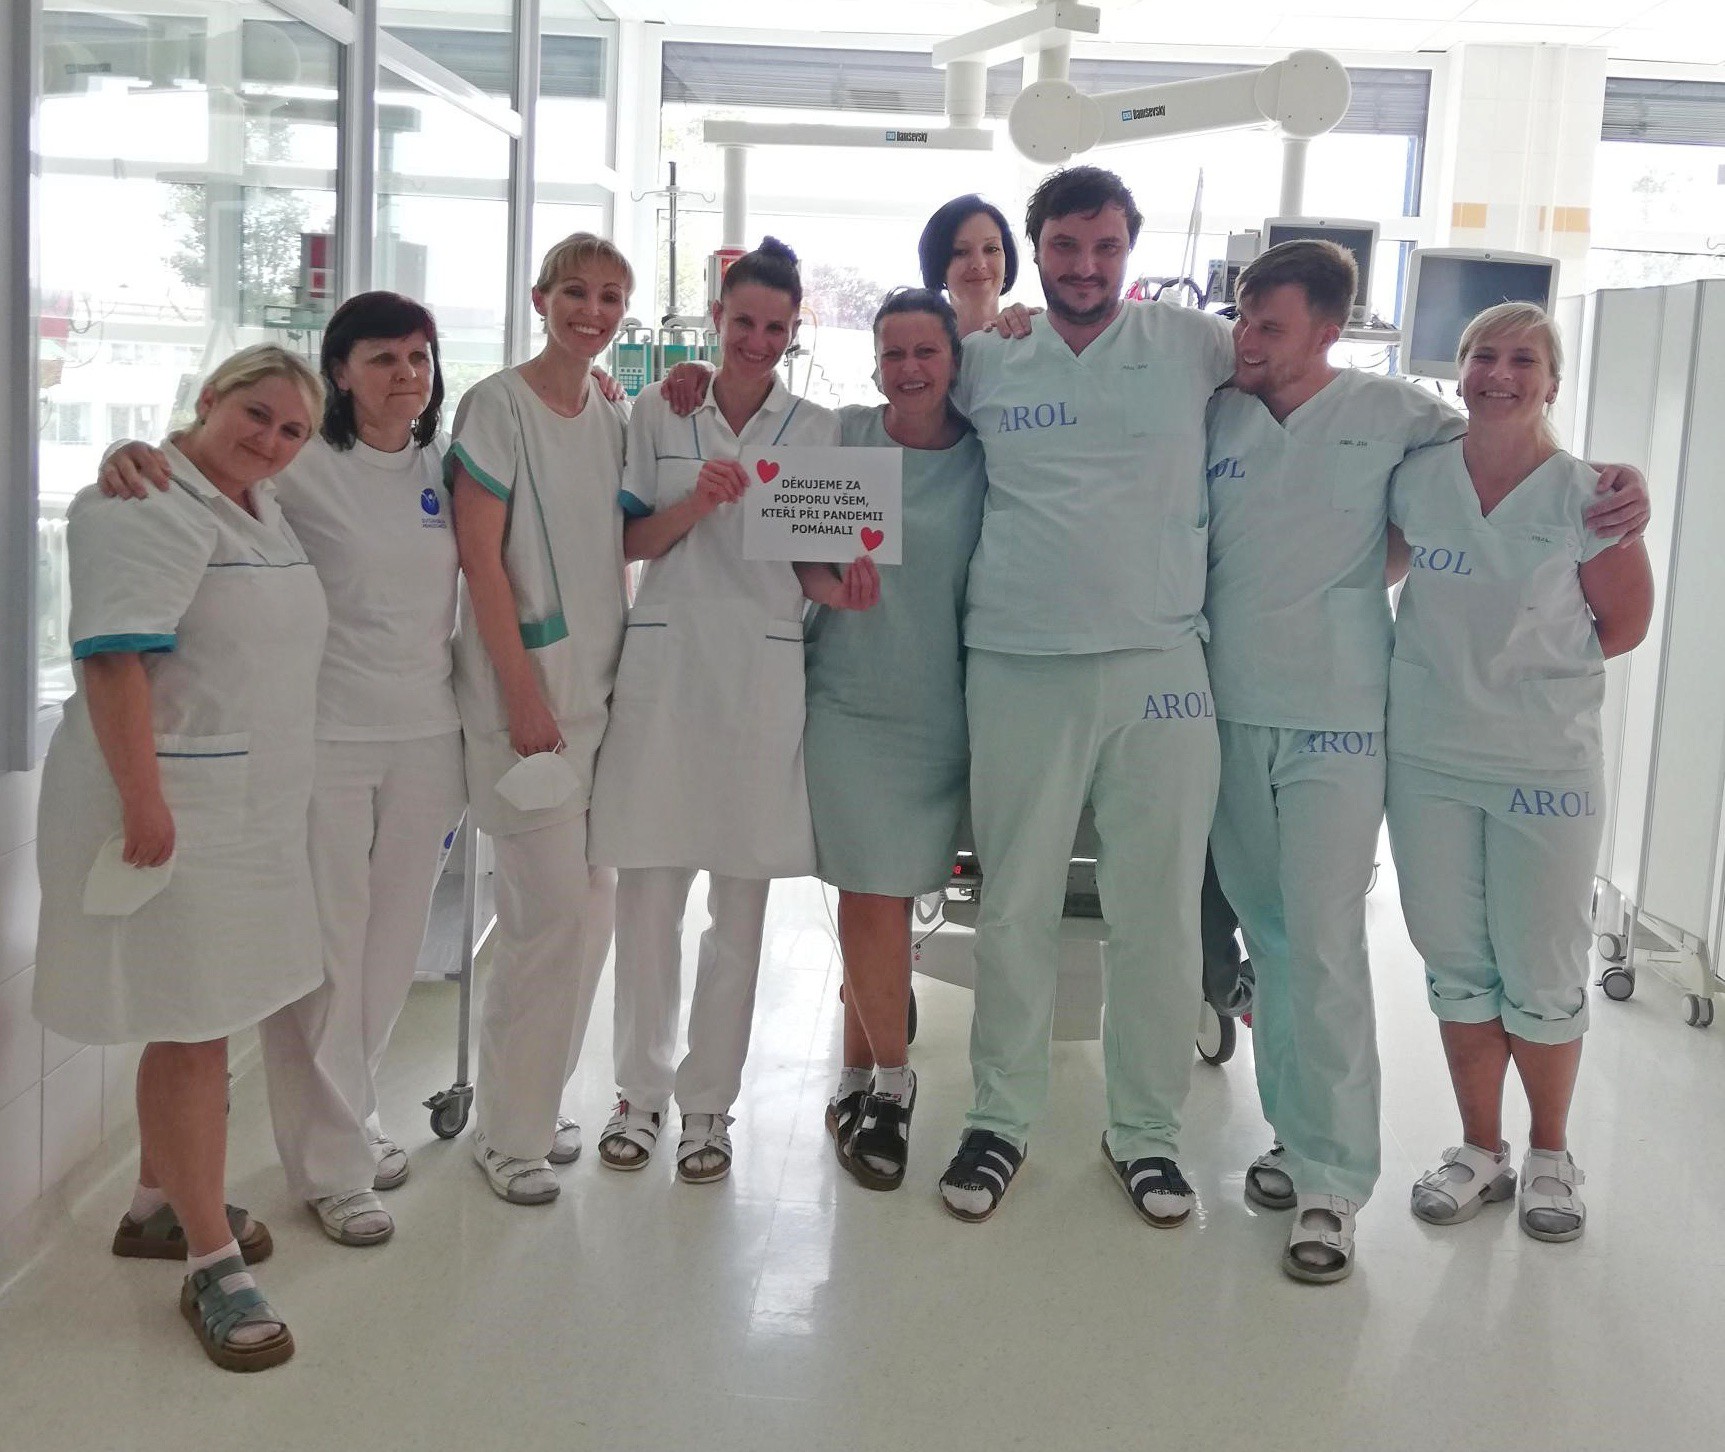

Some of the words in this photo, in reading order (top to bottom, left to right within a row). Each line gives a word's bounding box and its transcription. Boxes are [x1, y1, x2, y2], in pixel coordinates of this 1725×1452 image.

[998, 401, 1077, 433] AROL
[781, 476, 843, 490] DĚKUJEME
[845, 480, 861, 491] ZA
[774, 493, 830, 505] PODPORU
[833, 493, 870, 508] VŠEM,
[761, 506, 796, 519] KTEŘÍ
[799, 506, 820, 520] PŘI
[823, 510, 884, 522] PANDEMII
[791, 521, 854, 536] POMÁHALI
[1410, 545, 1473, 576] ROL
[1142, 691, 1214, 720] AROL
[1508, 787, 1597, 818] AROL
